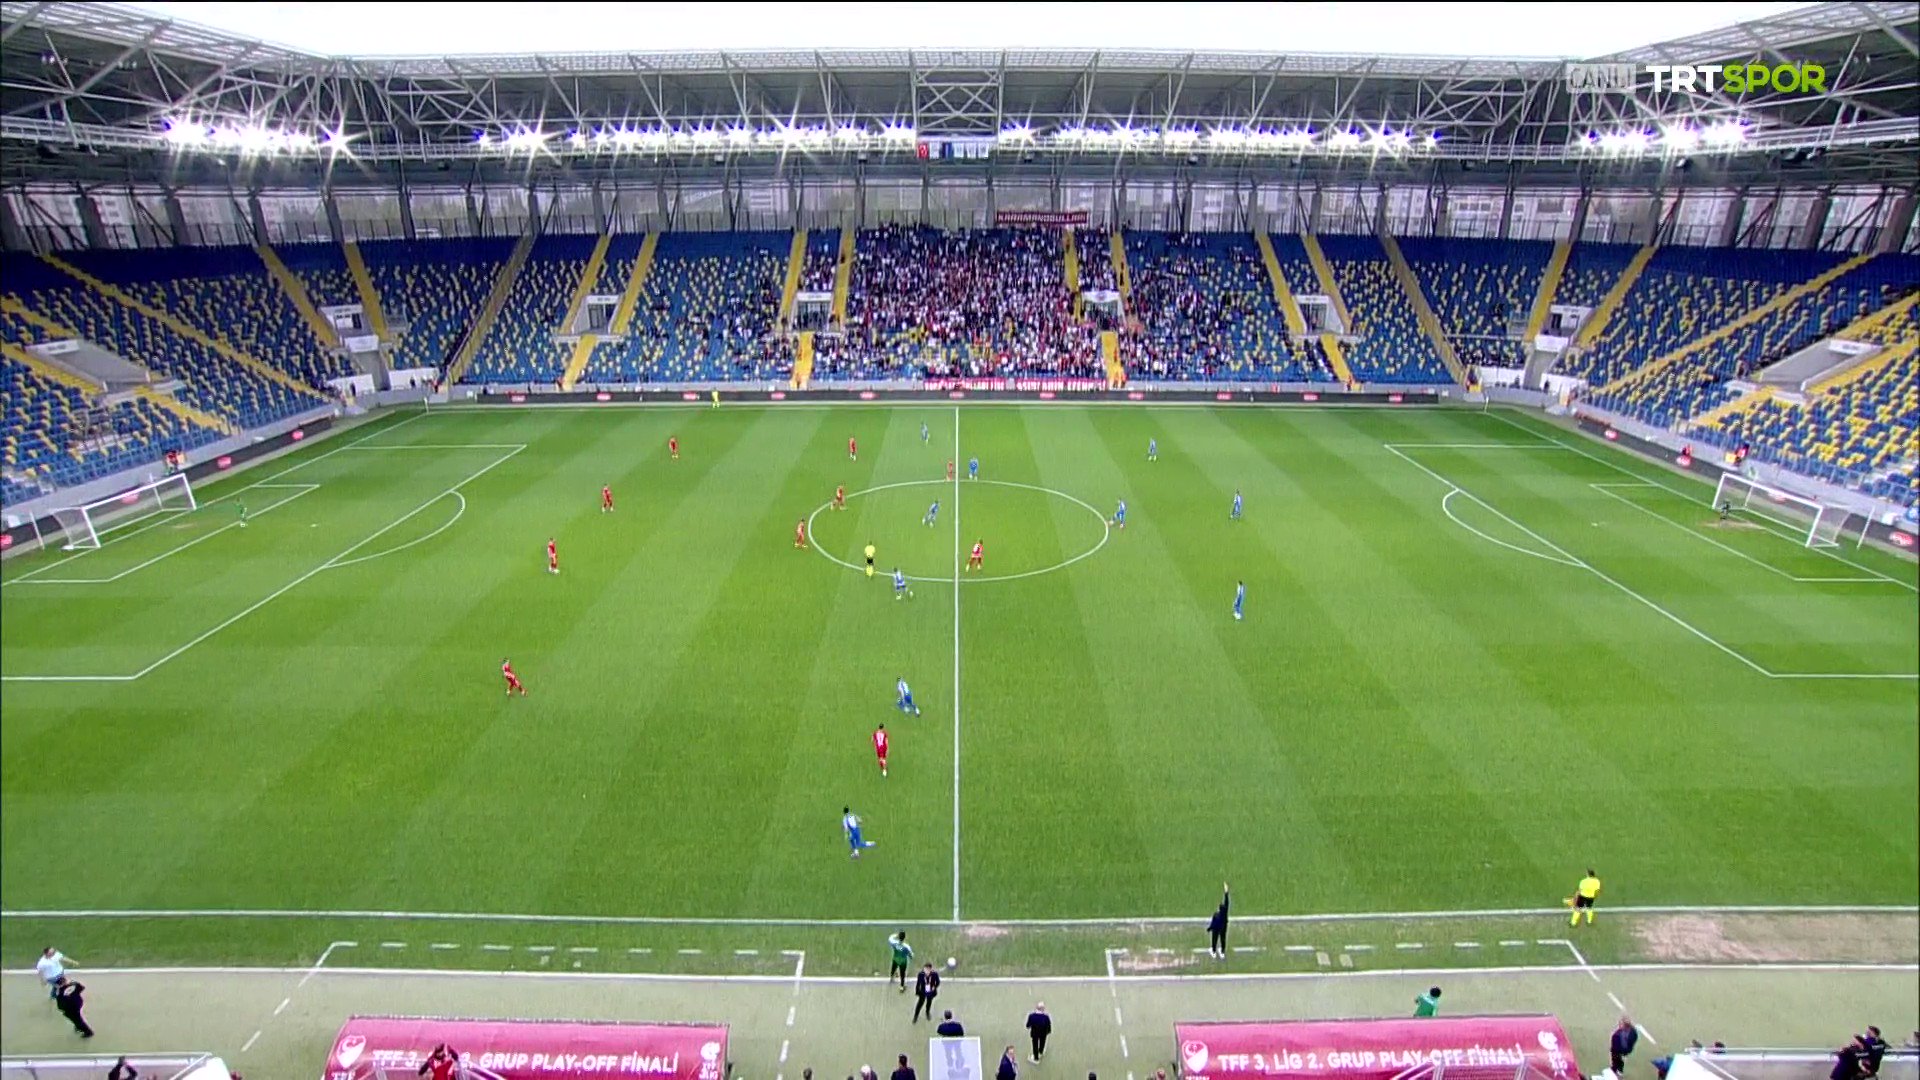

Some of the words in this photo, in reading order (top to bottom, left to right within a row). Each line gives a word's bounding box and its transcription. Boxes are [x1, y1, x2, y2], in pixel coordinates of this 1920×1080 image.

[371, 1049, 405, 1067] TFF
[478, 1052, 529, 1070] GRUP
[531, 1053, 618, 1072] PLAY-OFF
[620, 1050, 680, 1074] FİNALİ
[1218, 1053, 1249, 1072] TFF
[1274, 1048, 1303, 1070] LİG
[1306, 1052, 1323, 1069] 2.
[1327, 1051, 1376, 1069] GRUP
[1380, 1049, 1462, 1068] PLAY-OFF
[1467, 1043, 1525, 1067] FİNALİ
